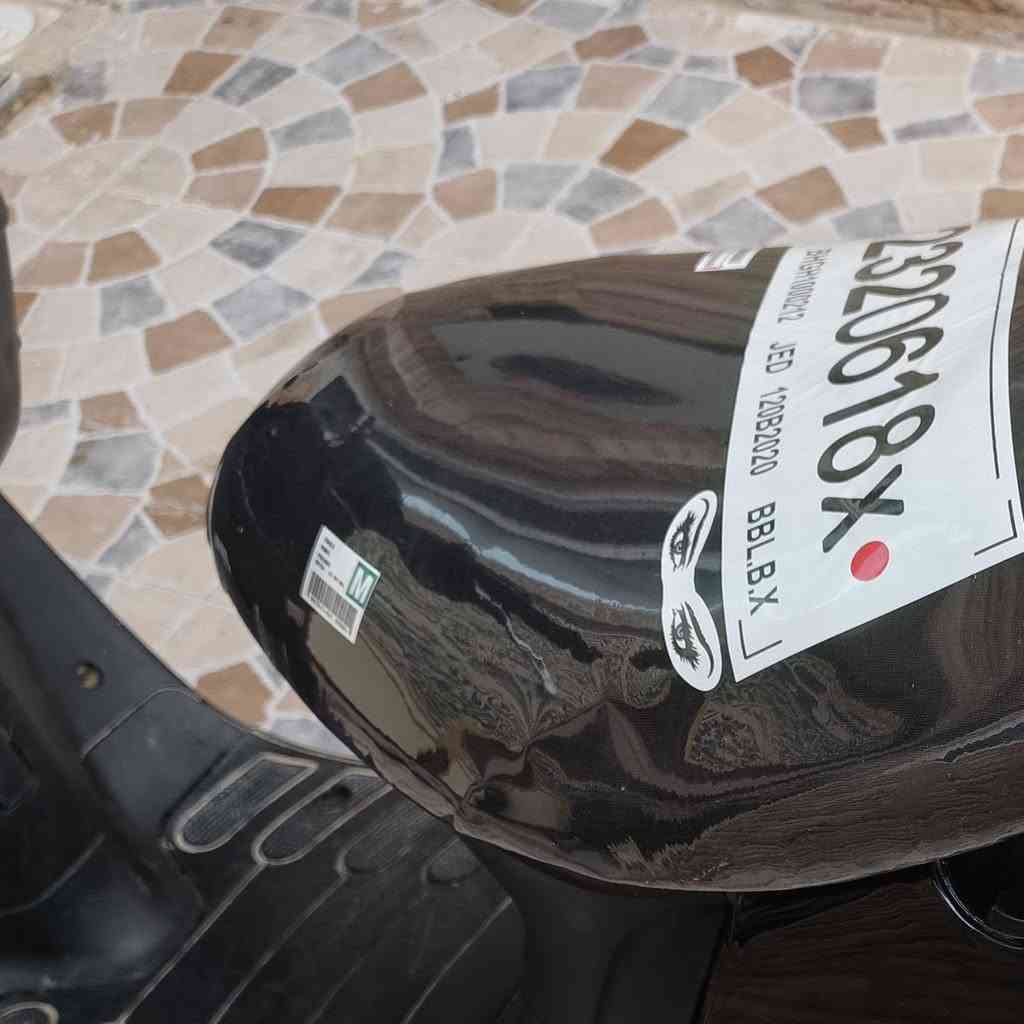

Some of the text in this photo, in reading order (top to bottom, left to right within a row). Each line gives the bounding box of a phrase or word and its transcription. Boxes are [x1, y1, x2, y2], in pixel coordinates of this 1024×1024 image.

[766, 341, 797, 375] JED
[750, 386, 790, 476] 120B2020
[746, 502, 779, 616] BBL.B.X
